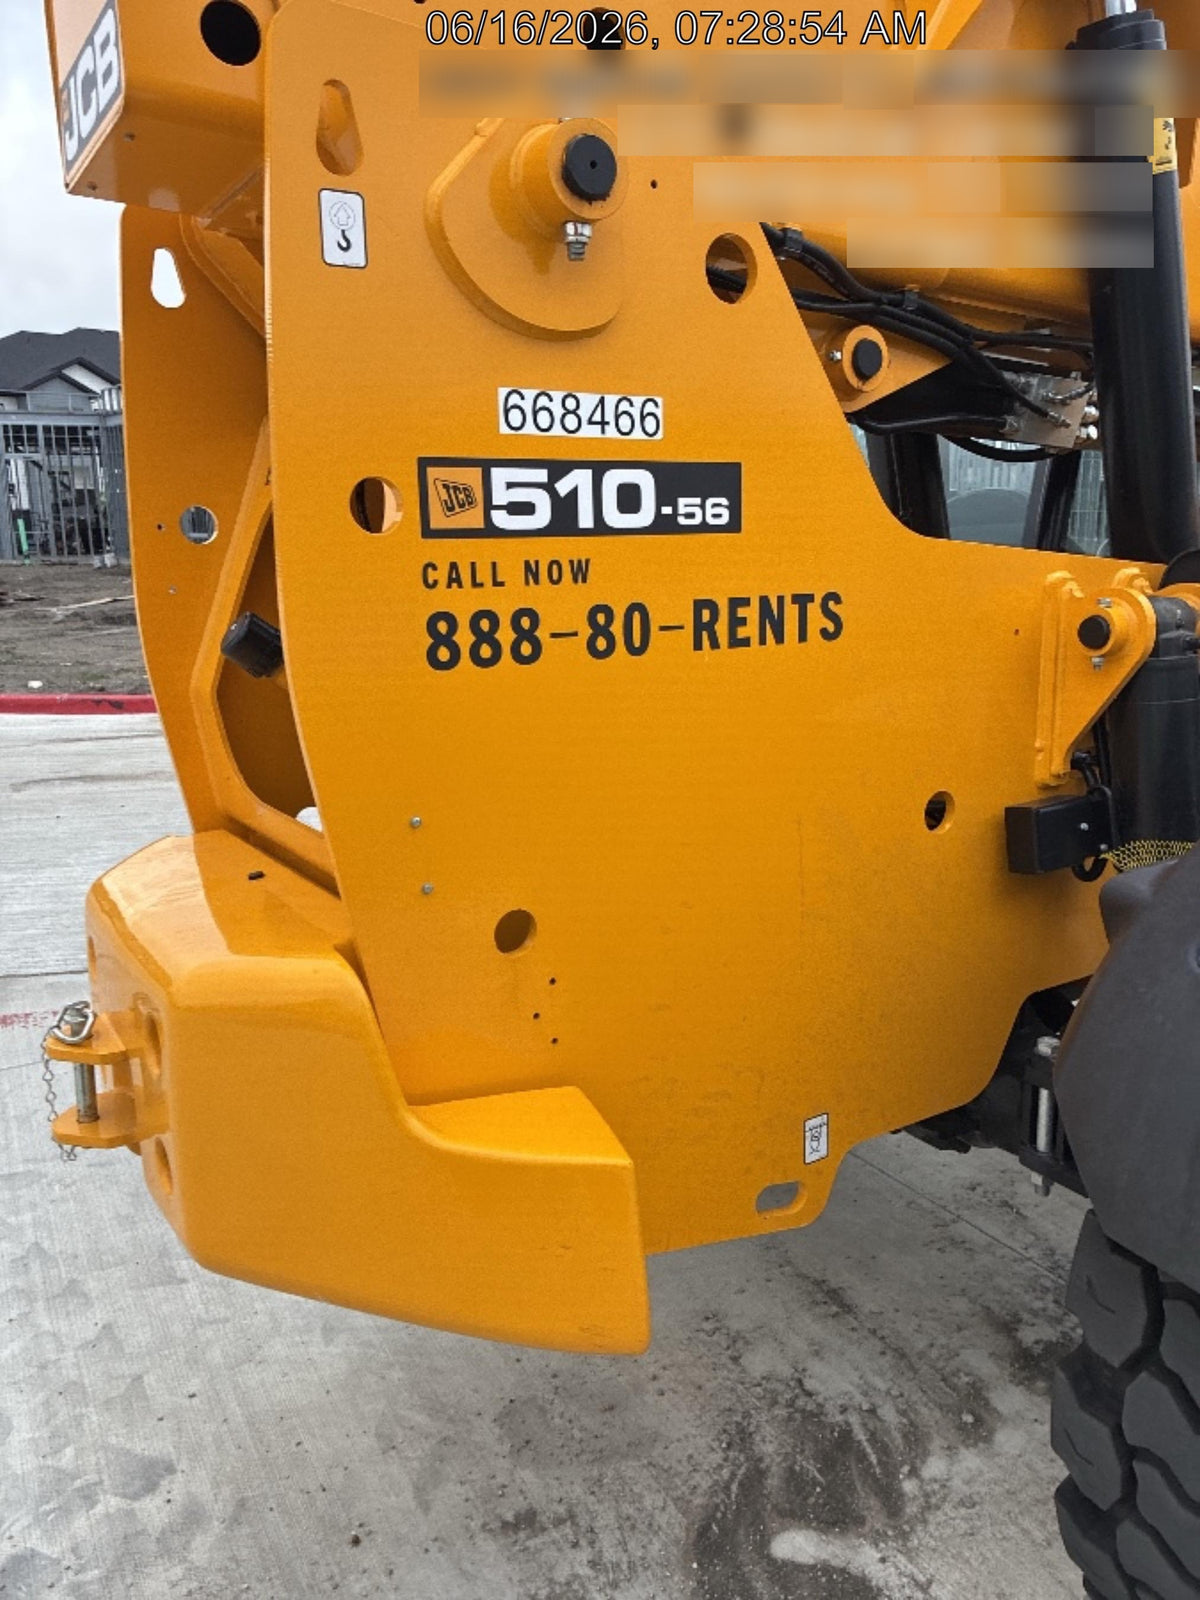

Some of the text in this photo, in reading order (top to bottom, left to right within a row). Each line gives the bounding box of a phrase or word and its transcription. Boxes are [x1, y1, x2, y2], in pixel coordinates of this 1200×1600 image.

[64, 8, 119, 161] JCB
[503, 389, 661, 438] 668466
[440, 467, 729, 530] JCB 510-56
[421, 558, 591, 590] CALL NOW
[425, 591, 844, 671] 888-80-RENTS
